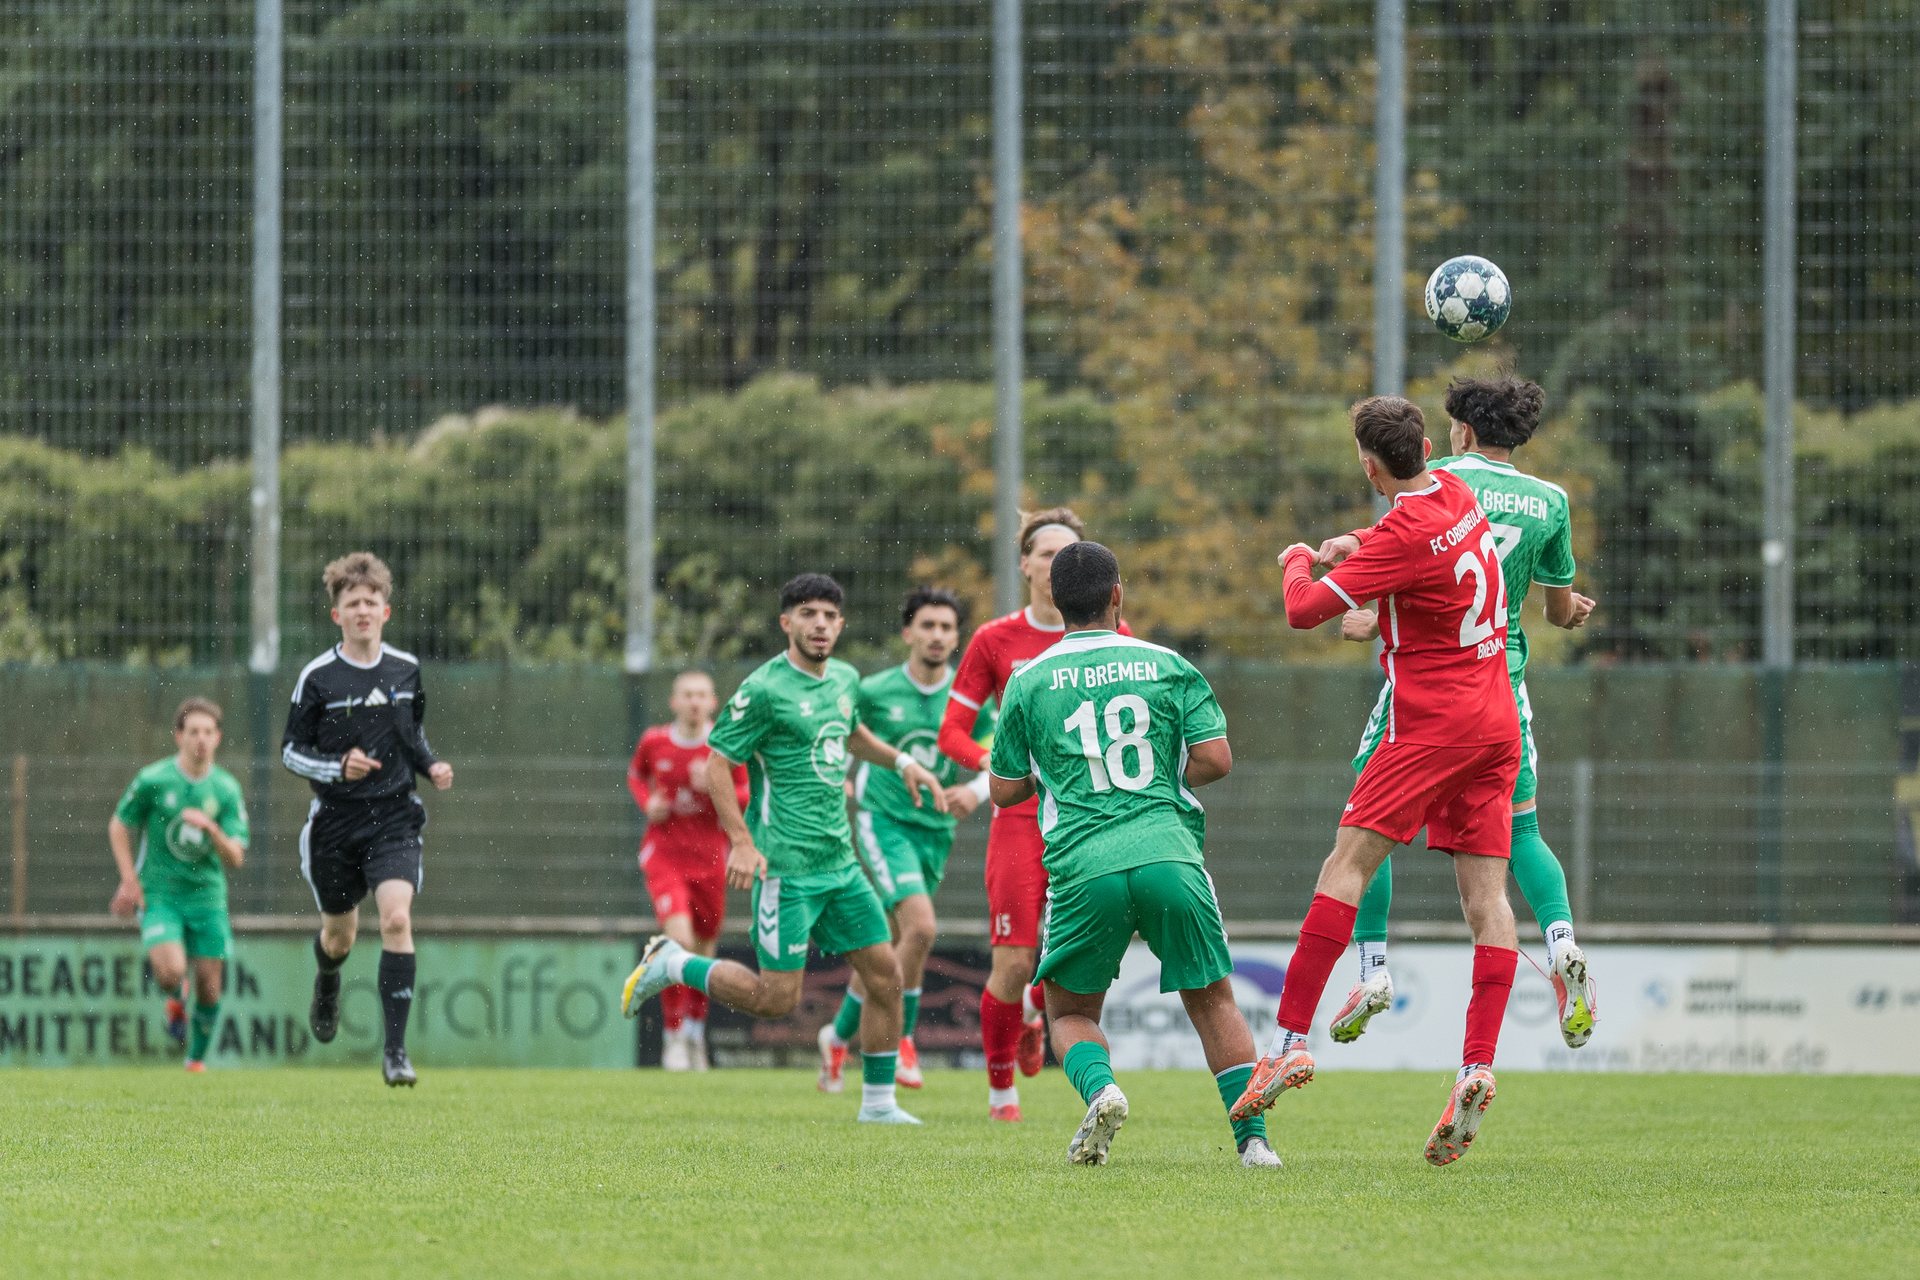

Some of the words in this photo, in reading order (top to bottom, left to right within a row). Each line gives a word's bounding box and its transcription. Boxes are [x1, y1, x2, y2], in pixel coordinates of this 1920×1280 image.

[1430, 535, 1448, 555] FC
[1446, 501, 1485, 546] OBERNEULA
[1483, 489, 1547, 521] BREMEN
[1454, 531, 1508, 648] 22
[1049, 668, 1079, 690] JFV
[1084, 661, 1158, 688] BREMEN
[1064, 694, 1155, 792] 18
[995, 914, 1011, 937] 15
[340, 956, 607, 1060] graffo
[0, 1012, 310, 1057] MITTELAND
